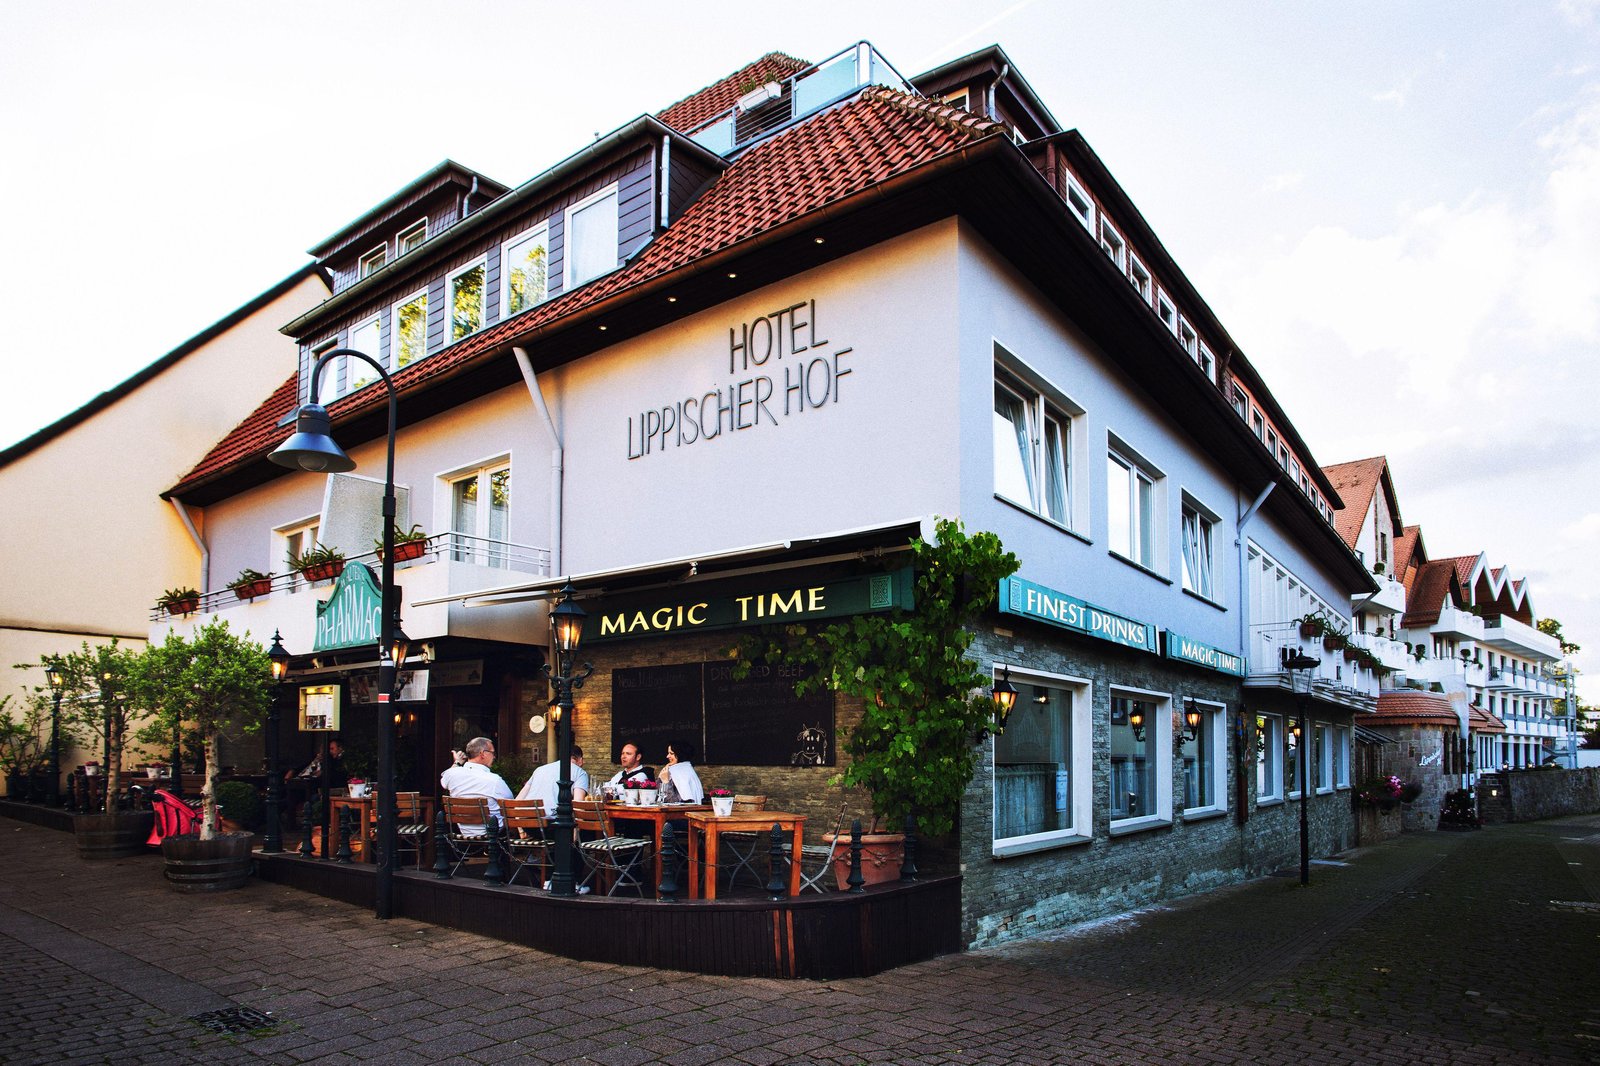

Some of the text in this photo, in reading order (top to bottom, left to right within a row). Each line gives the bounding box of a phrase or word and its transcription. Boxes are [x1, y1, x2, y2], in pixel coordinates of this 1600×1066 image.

[730, 299, 828, 374] HOTEL
[627, 347, 852, 460] LIPPISCHER HOF
[318, 583, 383, 648] PHARMAC
[600, 586, 826, 636] MAGIC TIME
[1026, 588, 1144, 644] FINEST DRINKS
[778, 664, 804, 677] BEEF
[1181, 640, 1237, 672] MAGIC TIME
